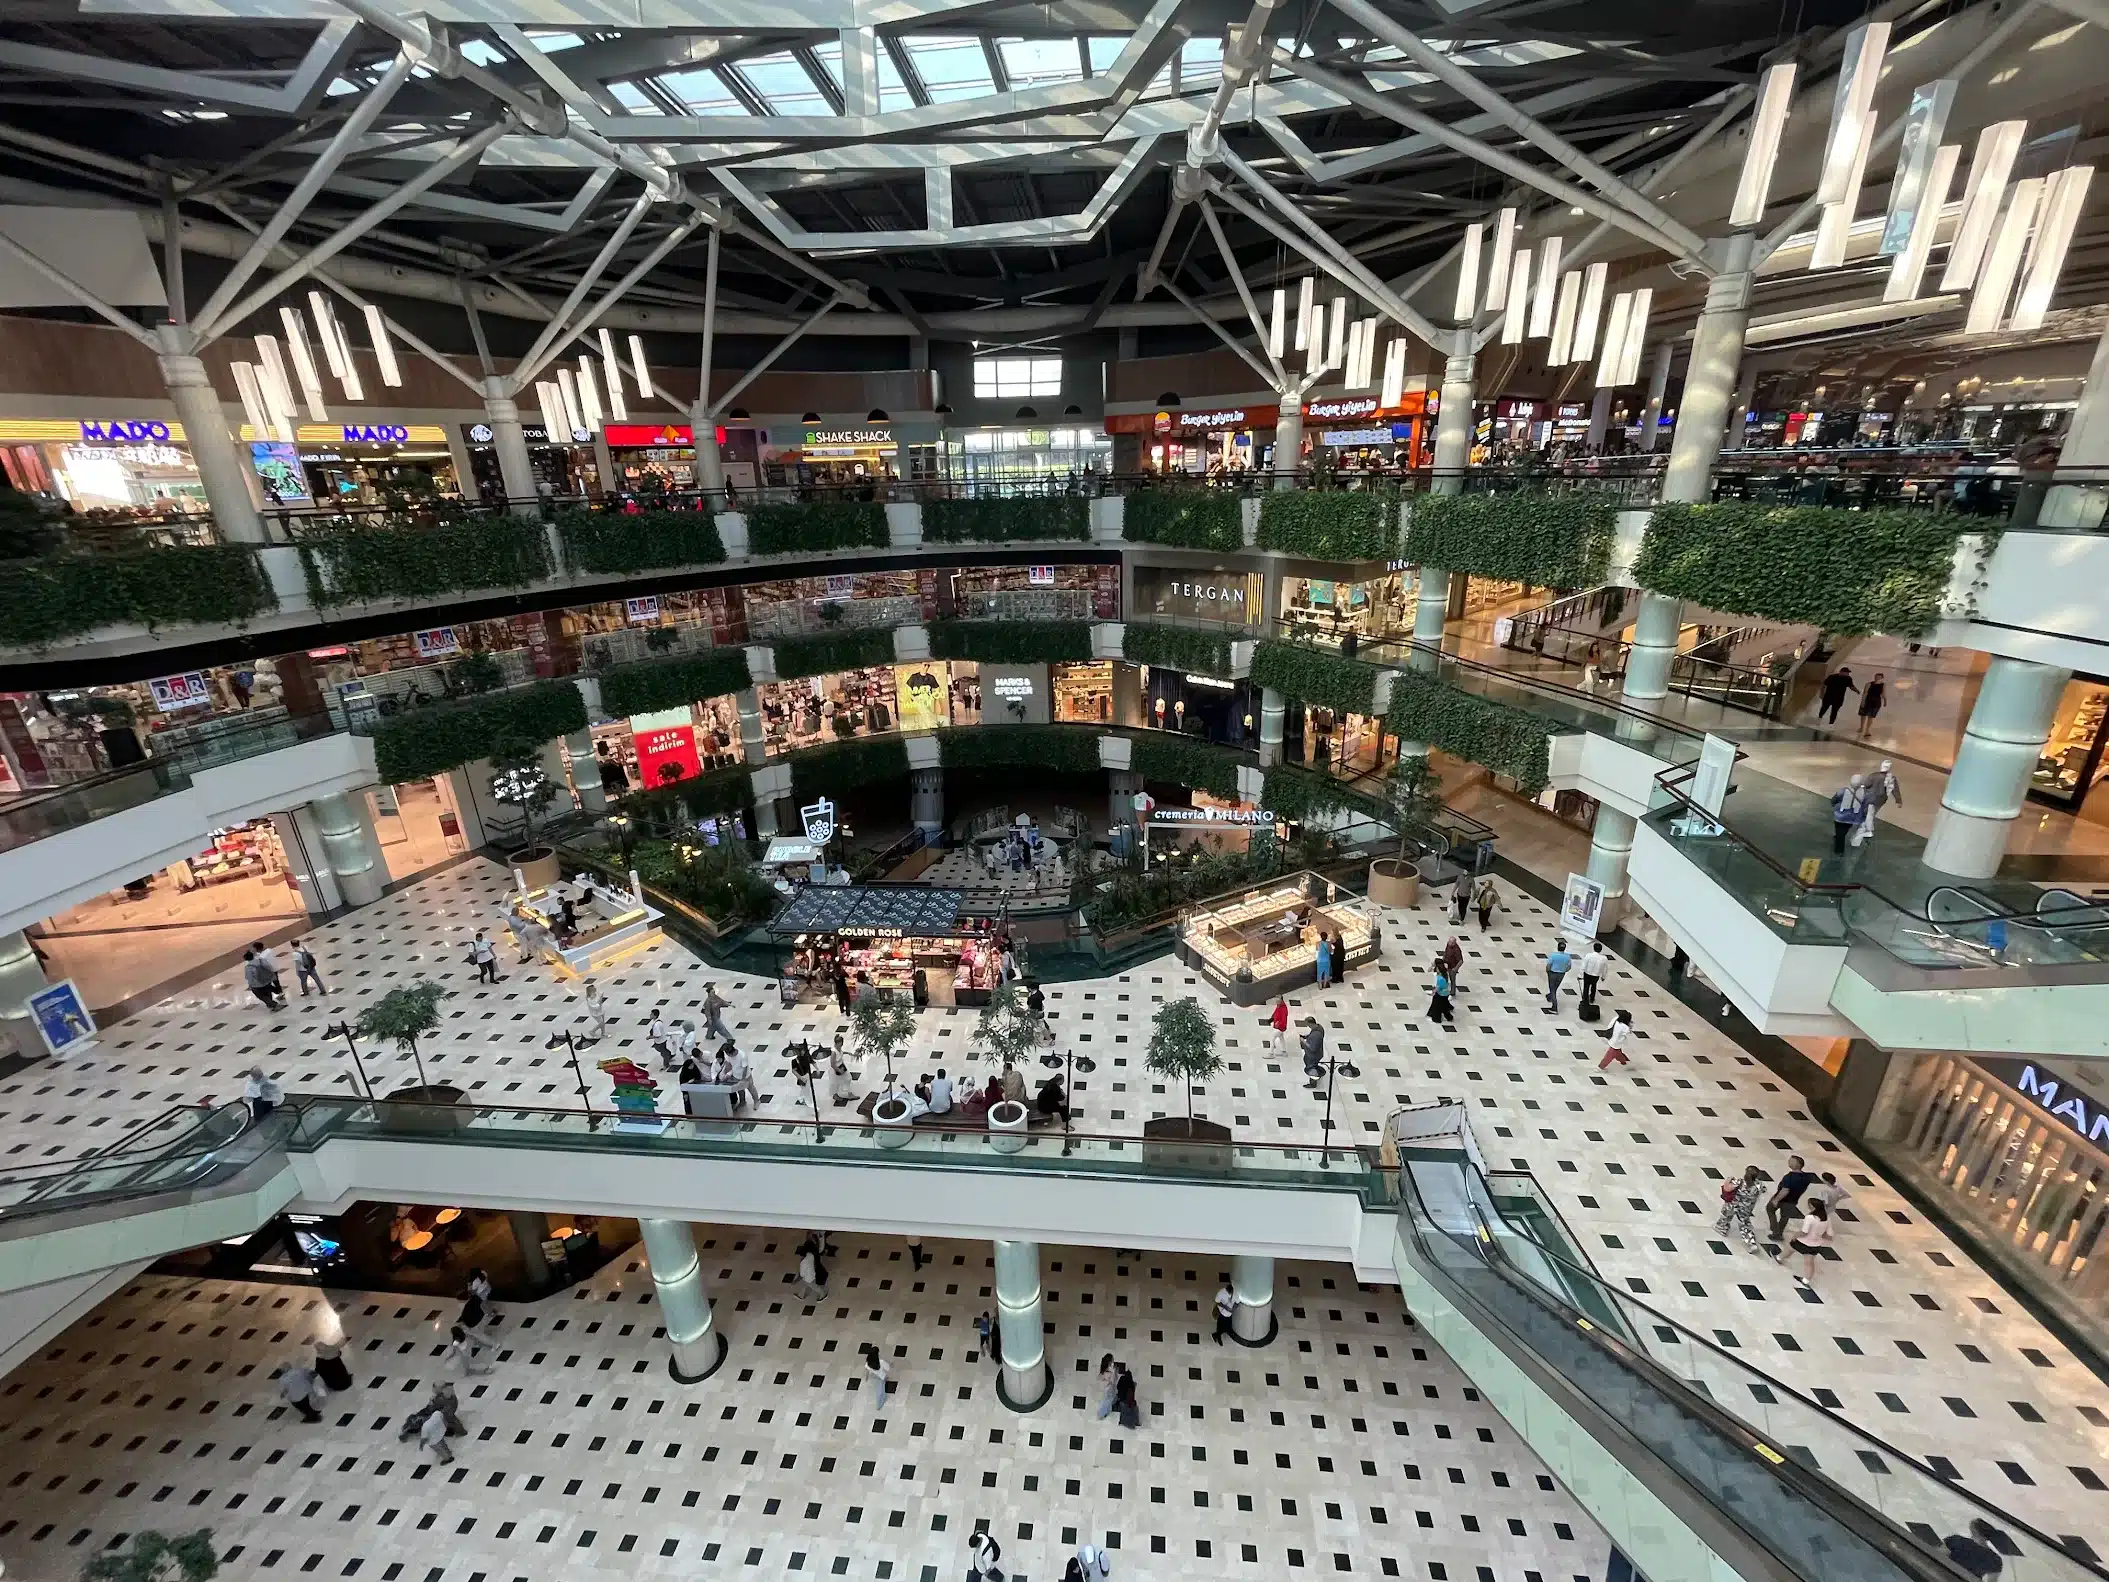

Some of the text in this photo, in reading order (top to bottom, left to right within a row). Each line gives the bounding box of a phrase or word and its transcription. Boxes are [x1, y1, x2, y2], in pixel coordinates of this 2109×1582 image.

[81, 420, 170, 441] MADO
[342, 425, 408, 442] MADO
[815, 430, 891, 443] SHAKE SHACK
[1171, 582, 1244, 603] TERGAN
[419, 632, 456, 649] D&R
[152, 679, 207, 701] D&R
[995, 678, 1024, 687] MARKS
[994, 686, 1034, 695] SPENCER
[1154, 810, 1274, 822] cremeria MILANO
[838, 928, 903, 938] GOLDEN ROSE
